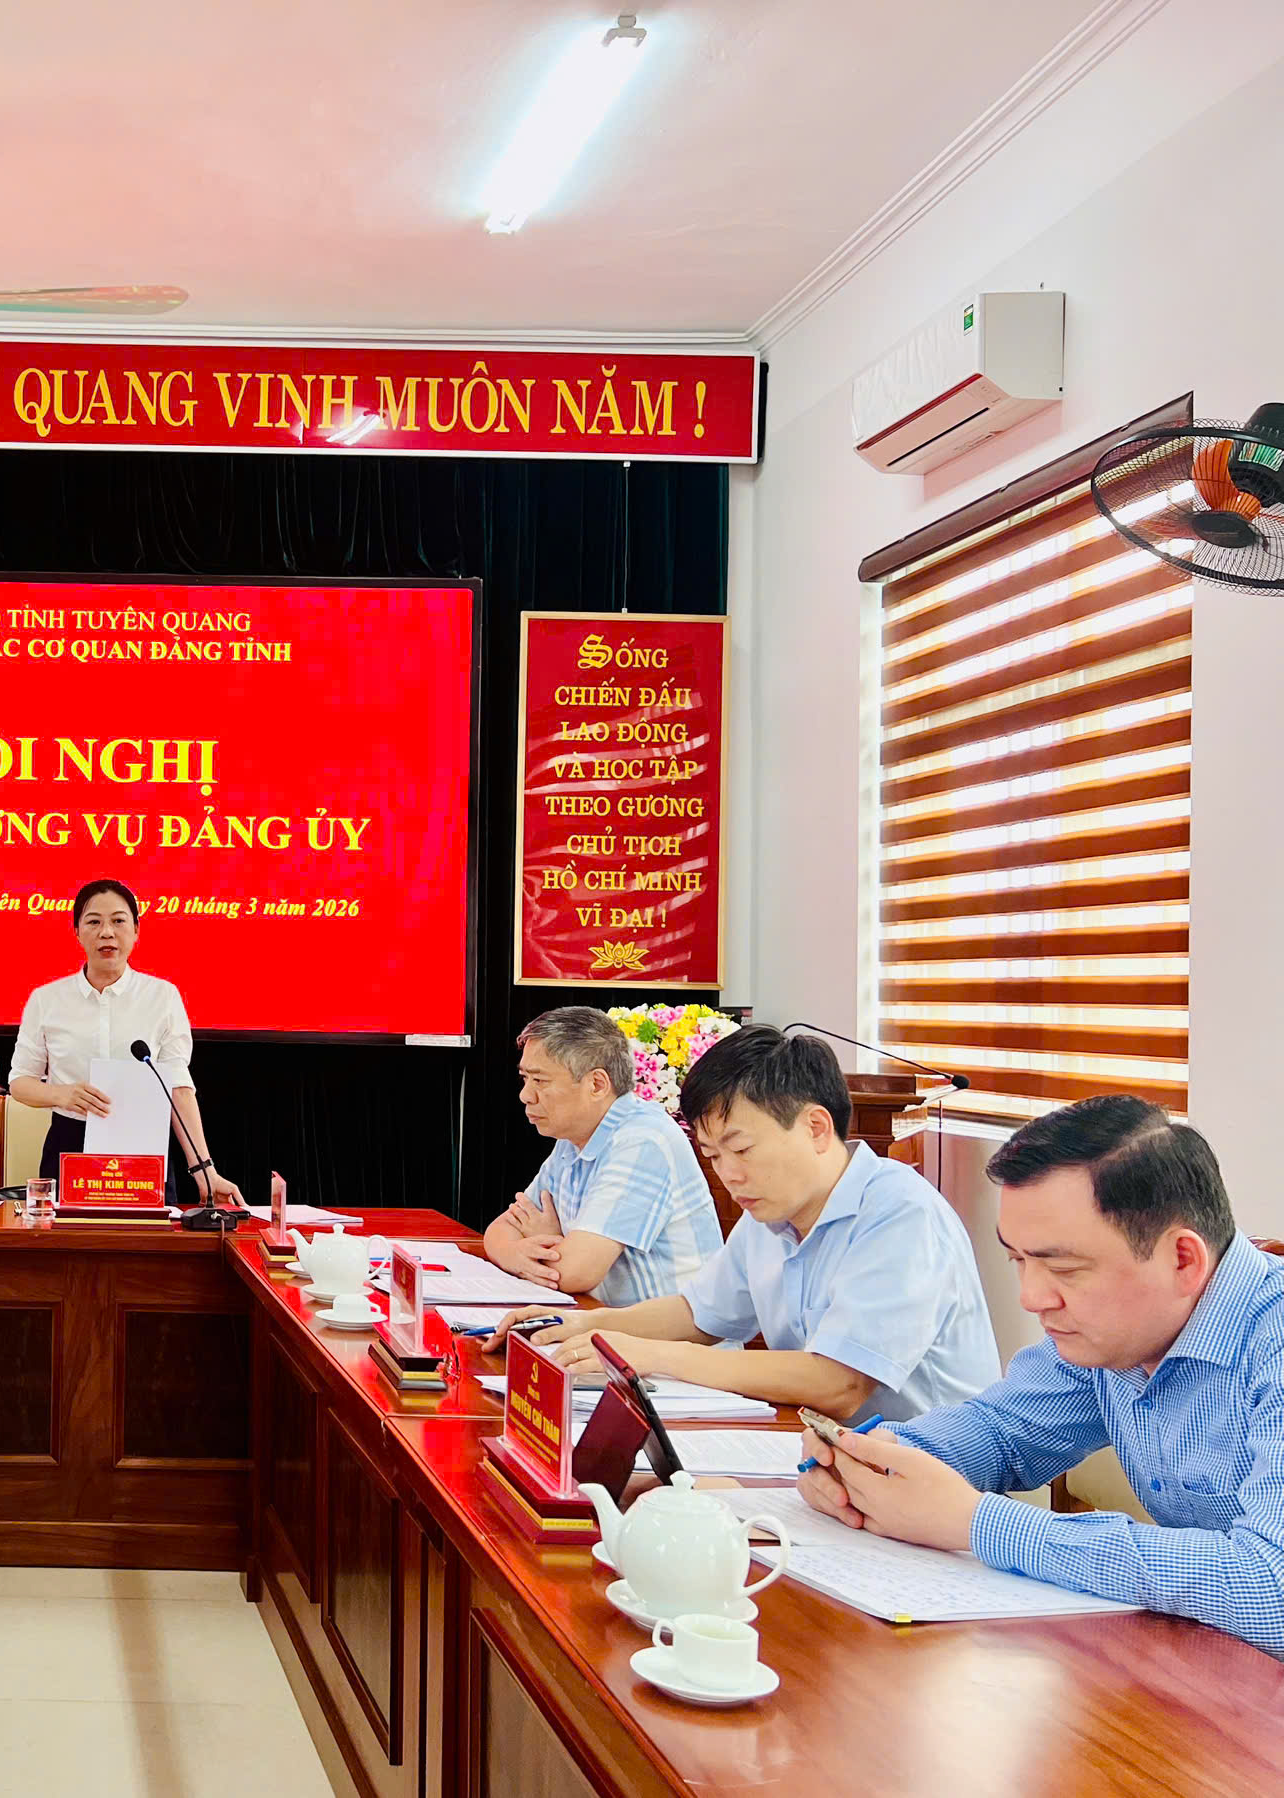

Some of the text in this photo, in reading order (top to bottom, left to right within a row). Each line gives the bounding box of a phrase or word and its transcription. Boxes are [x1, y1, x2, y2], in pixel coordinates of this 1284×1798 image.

[14, 368, 197, 437] QUANG
[213, 373, 356, 428] VINH
[375, 362, 536, 433] MUÔN
[552, 368, 676, 435] NĂM
[695, 382, 705, 437] !
[7, 604, 66, 629] TỈNH
[73, 606, 154, 630] TUYÊN
[164, 612, 250, 633] QUANG
[28, 640, 65, 658] CƠ
[71, 640, 142, 662] QUAN
[150, 635, 223, 662] ĐẢNG
[228, 636, 293, 662] TỈNH
[578, 634, 668, 668] SỐNG
[555, 677, 692, 709] CHIẾN ĐẤU
[561, 719, 687, 746] LAO ĐỘNG
[54, 738, 218, 796] NGHỊ
[556, 752, 699, 785] VÀ HỌC TẬP
[546, 796, 702, 816] THEO GƯƠNG
[84, 814, 146, 855] VỤ
[159, 806, 292, 849] ĐẢNG
[308, 808, 370, 850] ỦY
[567, 826, 682, 860] CHỦ TỊCH
[542, 860, 700, 892] HỒ CHÍ MINH
[156, 896, 179, 912] 20
[185, 896, 241, 918] tháng
[248, 898, 258, 914] 3
[264, 899, 305, 915] năm
[313, 899, 359, 916] 2026
[577, 904, 667, 933] VĨ ĐẠI !
[74, 1179, 84, 1188] LÊ
[87, 1179, 103, 1191] THỊ
[127, 1181, 154, 1190] DUNG
